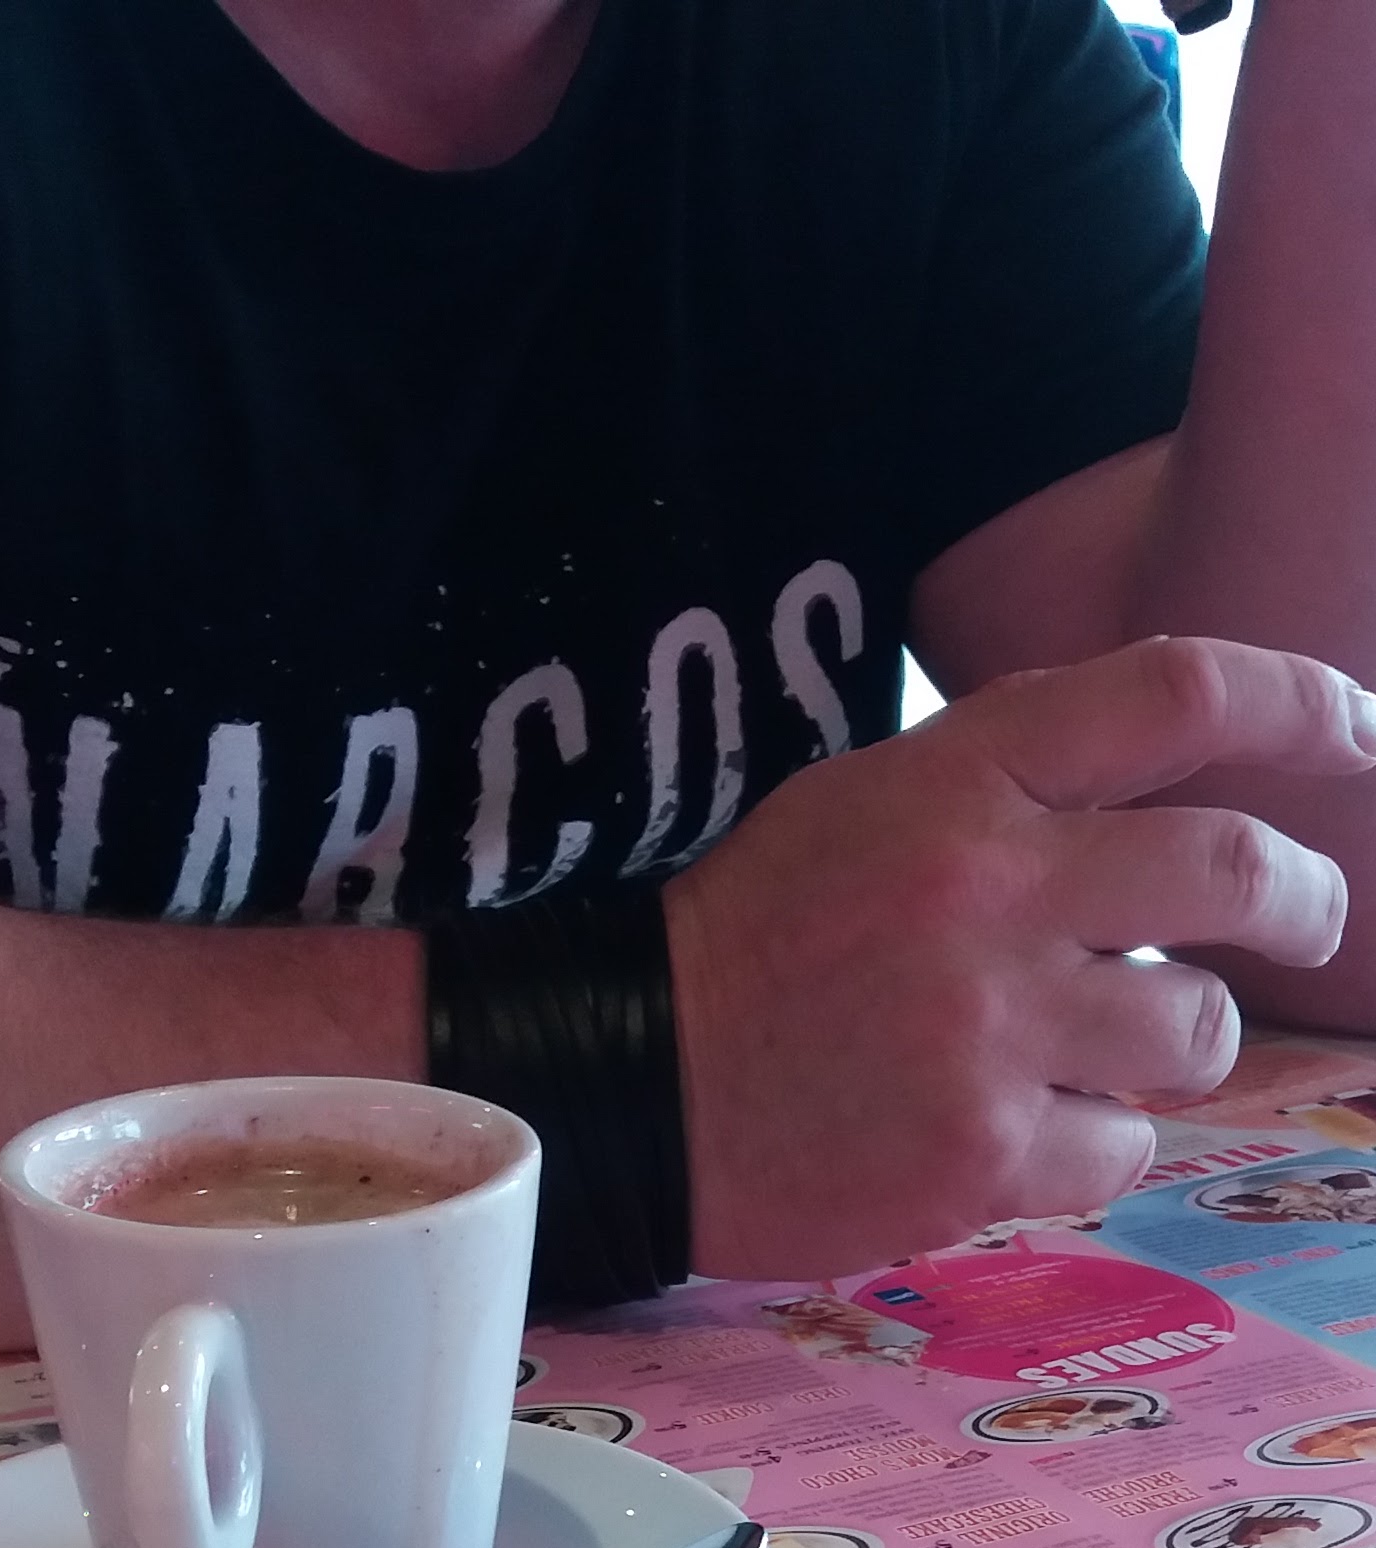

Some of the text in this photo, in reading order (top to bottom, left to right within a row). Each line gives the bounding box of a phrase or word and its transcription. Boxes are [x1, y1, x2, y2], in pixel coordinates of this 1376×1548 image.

[1016, 1322, 1237, 1389] SUNDAES
[801, 1464, 880, 1490] CHOCO
[1081, 1471, 1186, 1504] BRIOCHE
[896, 1497, 1048, 1540] CHEESECAKE
[1107, 1486, 1205, 1518] FRENCH
[958, 1510, 1071, 1546] ORIGINAL
